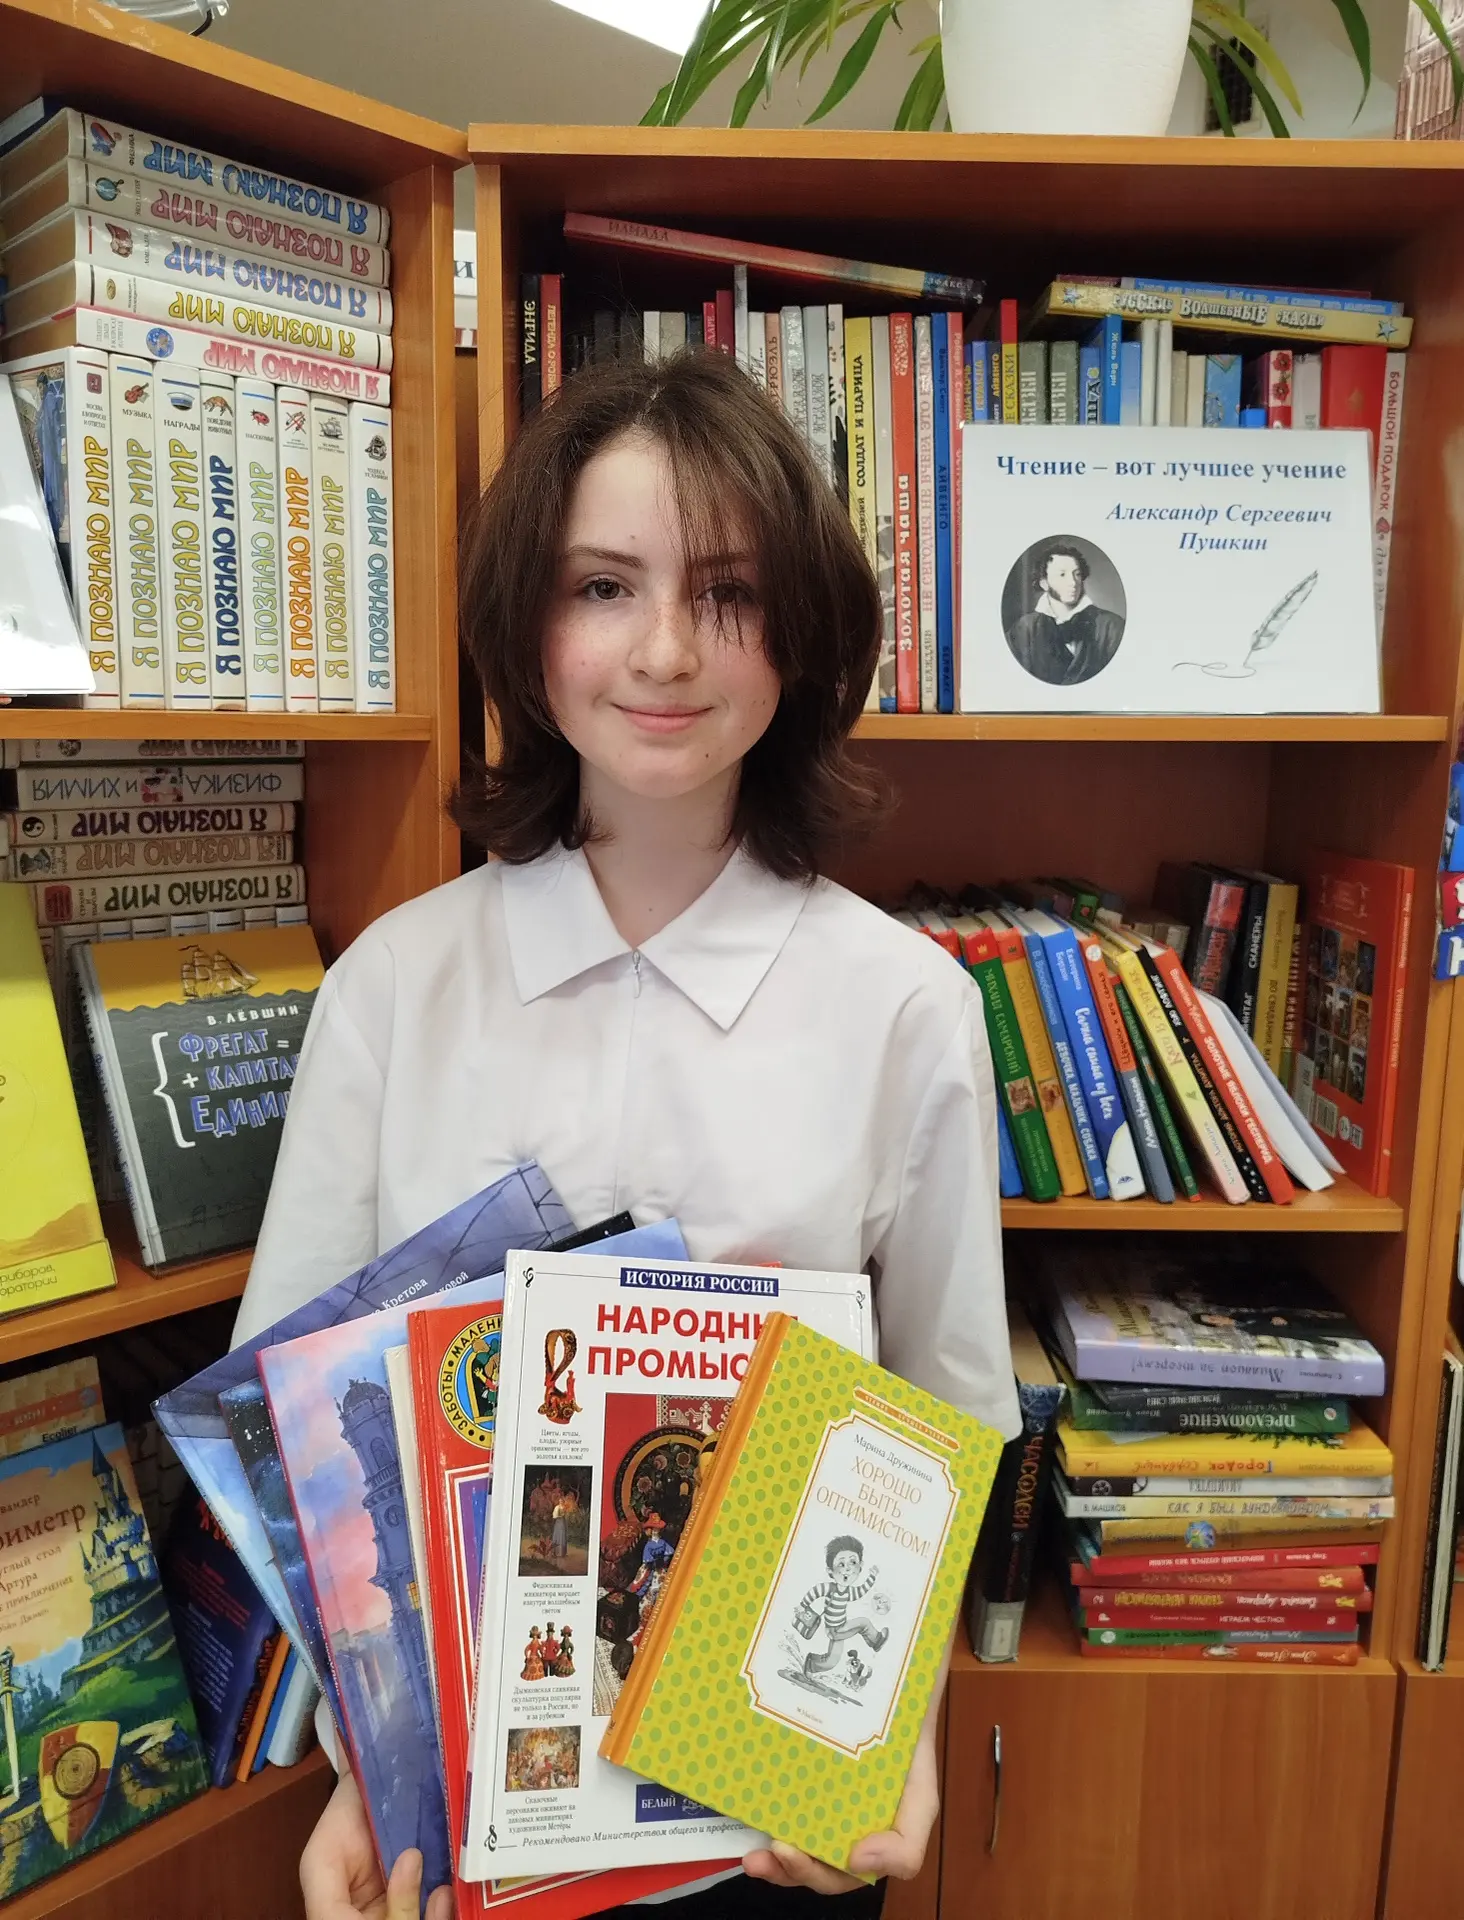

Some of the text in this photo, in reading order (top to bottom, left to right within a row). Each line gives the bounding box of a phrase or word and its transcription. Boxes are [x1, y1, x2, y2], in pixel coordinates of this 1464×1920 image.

[143, 140, 368, 234] Я ПОЗНАЮ МИР
[150, 189, 370, 277] Я ПОЗНАЮ МИР
[164, 242, 366, 316] Я ПОЗНАЮ МИР
[169, 292, 224, 325] МИР
[546, 304, 556, 348] ЛЕГЕНДА
[1179, 297, 1269, 325] ВОЛШЕБНЫЕ
[232, 307, 332, 350] ПОЗНАЮ
[338, 331, 355, 359] Я
[523, 300, 536, 365] ЭНЕИДА
[953, 332, 962, 365] Роберт
[1111, 332, 1119, 386] Жюль Верн
[204, 341, 380, 399] Я ПОЗНАЮ МИР
[992, 353, 1000, 397] АЙВЕНГО
[1005, 354, 1015, 410] СКАЗКИ
[122, 408, 152, 420] МУЗЫКА
[163, 420, 200, 432] НАГРАДЫ
[853, 355, 865, 488] СОЛДАТ И ЦАРИЦА
[921, 401, 931, 430] ЭТО
[1379, 371, 1400, 511] БОЛЬШОЙ ПОДАРОК
[920, 434, 932, 486] ВЧЕРА
[995, 455, 1347, 484] Чтение вот лучшее учение
[285, 467, 309, 530] МИР
[921, 490, 932, 514] НЕ
[939, 465, 948, 530] АЙВЕНГО
[1105, 502, 1333, 527] Александр Сергеевич
[84, 435, 115, 673] Я ПОЗНАЮ МИР
[127, 438, 159, 669] Я ПОЗНАЮ МИР
[169, 438, 206, 684] Я ПОЗНАЮ МИР
[1177, 532, 1268, 555] Пушкин
[209, 455, 241, 675] Я ПОЗНАЮ МИР
[249, 461, 278, 673] Я ПОЗНАЮ МИР
[321, 475, 349, 679] Я ПОЗНАЮ МИР
[898, 474, 913, 651] Золотая чаша
[287, 536, 313, 650] ПОЗНАЮ
[366, 488, 390, 689] Я ПОЗНАЮ МИР
[922, 589, 933, 612] НЕ
[291, 658, 315, 678] Я
[33, 771, 282, 801] ФИЗИКА и ХИМИЯ
[71, 808, 267, 837] Я ПОЗНАЮ МИР
[76, 841, 136, 872] МИР
[143, 837, 251, 866] ПОЗНАЮ
[257, 836, 275, 861] Я
[104, 874, 293, 913] Я ПОЗНАЮ МИР
[1248, 914, 1263, 969] СКАНЕРЫ
[1066, 947, 1082, 991] Екатерина
[207, 1004, 299, 1026] В. ЛЁВШИН
[1150, 973, 1182, 1027] ХЬЮ ЛОФТИНГ
[983, 967, 1022, 1076] МИХАИЛ САМАРСКИЙ
[179, 1029, 269, 1063] ФРЕГАТ
[1055, 1041, 1097, 1162] ДЕВОЧКА, МАЛЬЧИК, СОБАКА
[1203, 1035, 1273, 1165] ЗОЛОТЫЕ ЯБЛОКИ ГЕСПЕРИД
[381, 1277, 428, 1310] Кретова
[624, 1269, 775, 1295] ИСТОРИЯ РОССИИ
[596, 1303, 799, 1342] НАРОДН
[587, 1345, 751, 1382] ПРОМЫС
[1132, 1359, 1196, 1374] теорему!
[1199, 1363, 1215, 1374] за
[1221, 1364, 1285, 1385] Миллион
[441, 1371, 468, 1432] ЗАБОТЫ
[42, 1426, 78, 1443] Ecolier
[1179, 1412, 1296, 1429] ПРЕЛОМЛЕНИЕ
[854, 1433, 933, 1484] Марина Дружинина
[1209, 1460, 1274, 1474] Городок
[851, 1455, 922, 1505] ХОРОШО
[0, 1493, 41, 1514] вандер
[857, 1482, 903, 1519] БЫТЬ
[1091, 1504, 1126, 1513] МАШКОВ
[1166, 1502, 1331, 1515] КАК Я БЫЛ ВУНДЕРКИНДОМ
[816, 1484, 933, 1559] ОПТИМИСТОМ!
[36, 1546, 62, 1562] стол
[1219, 1616, 1250, 1624] ИГРАЕМ
[641, 1794, 676, 1809] БЕЛЫЙ
[522, 1834, 591, 1847] Рекомендовано
[593, 1829, 667, 1842] Министерством
[669, 1826, 698, 1837] общего
[705, 1823, 745, 1835] професси
